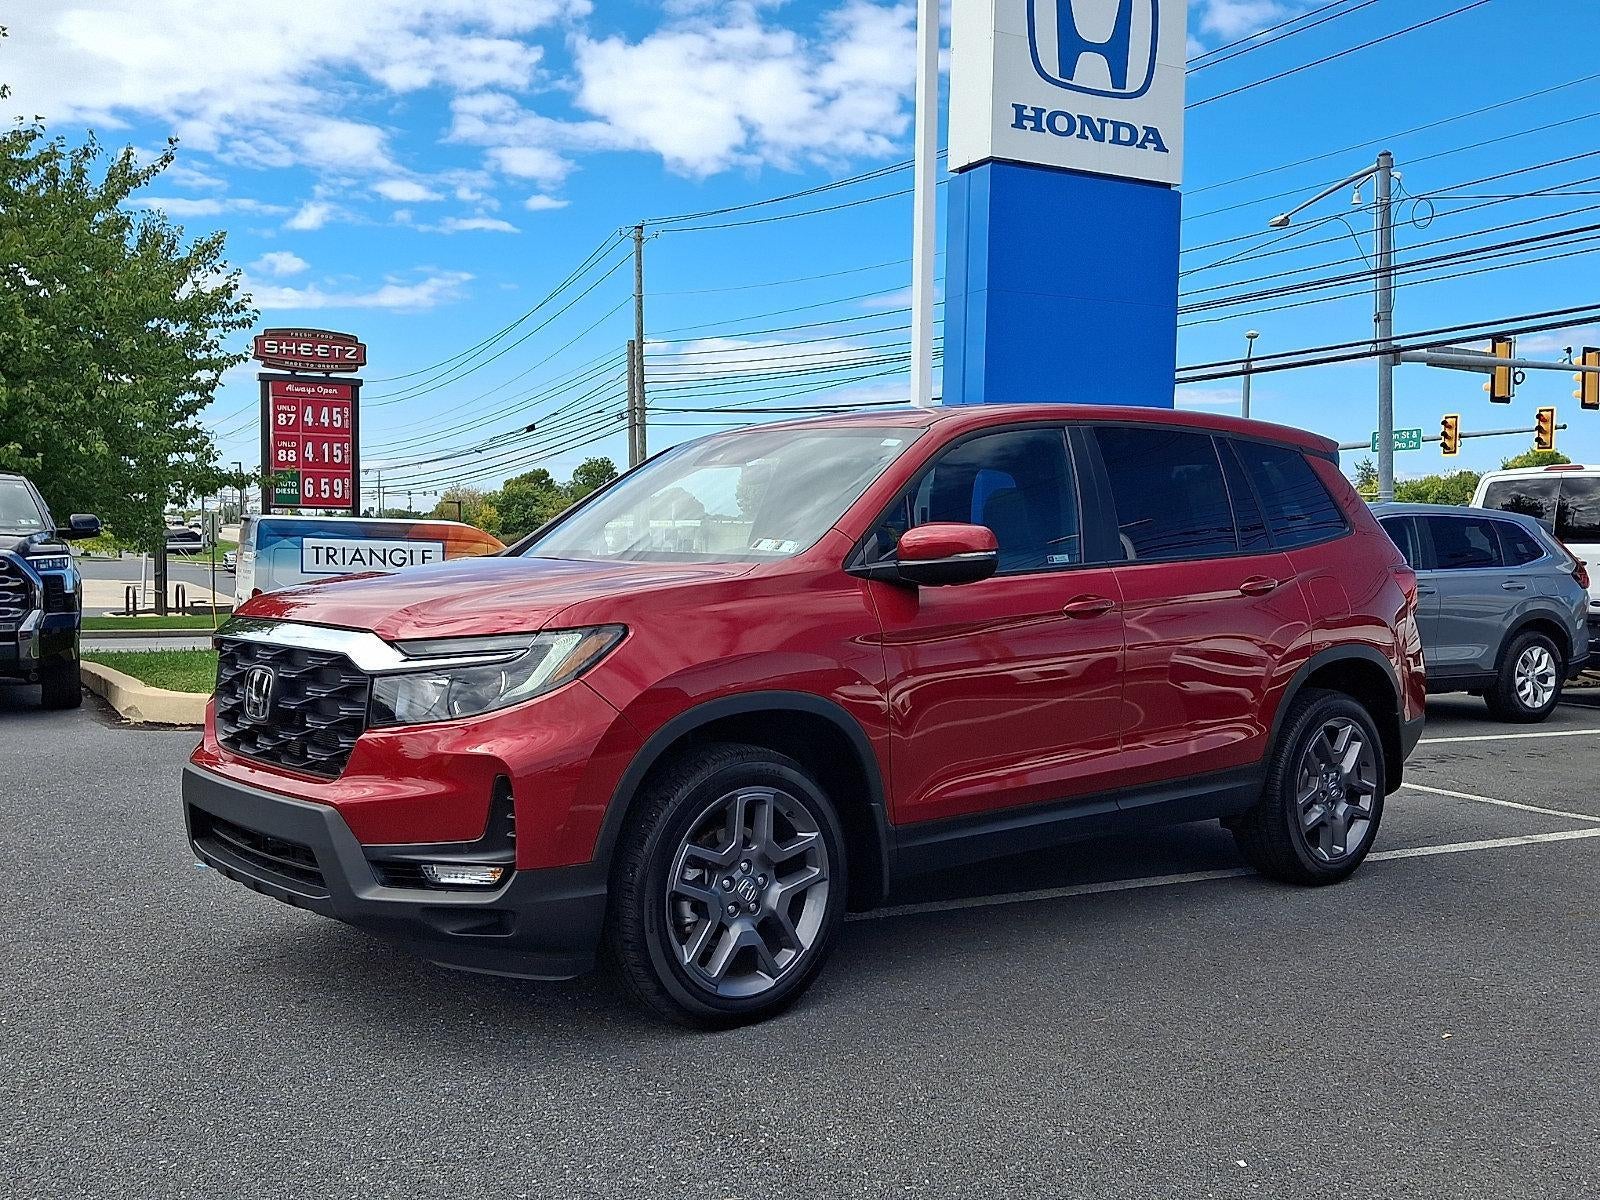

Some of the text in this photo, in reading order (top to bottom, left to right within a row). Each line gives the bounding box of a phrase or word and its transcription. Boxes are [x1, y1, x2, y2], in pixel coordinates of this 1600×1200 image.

[1011, 103, 1169, 153] HONDA
[264, 340, 358, 360] SHEETZ
[286, 384, 338, 395] Always Open
[277, 413, 296, 426] 87
[304, 405, 342, 428] 4.45
[1394, 440, 1419, 449] Pro Dr
[1401, 431, 1410, 439] St
[277, 449, 297, 462] 88
[304, 441, 342, 463] 4.15
[304, 477, 343, 499] 6.59
[311, 546, 433, 568] TRIANGLE
